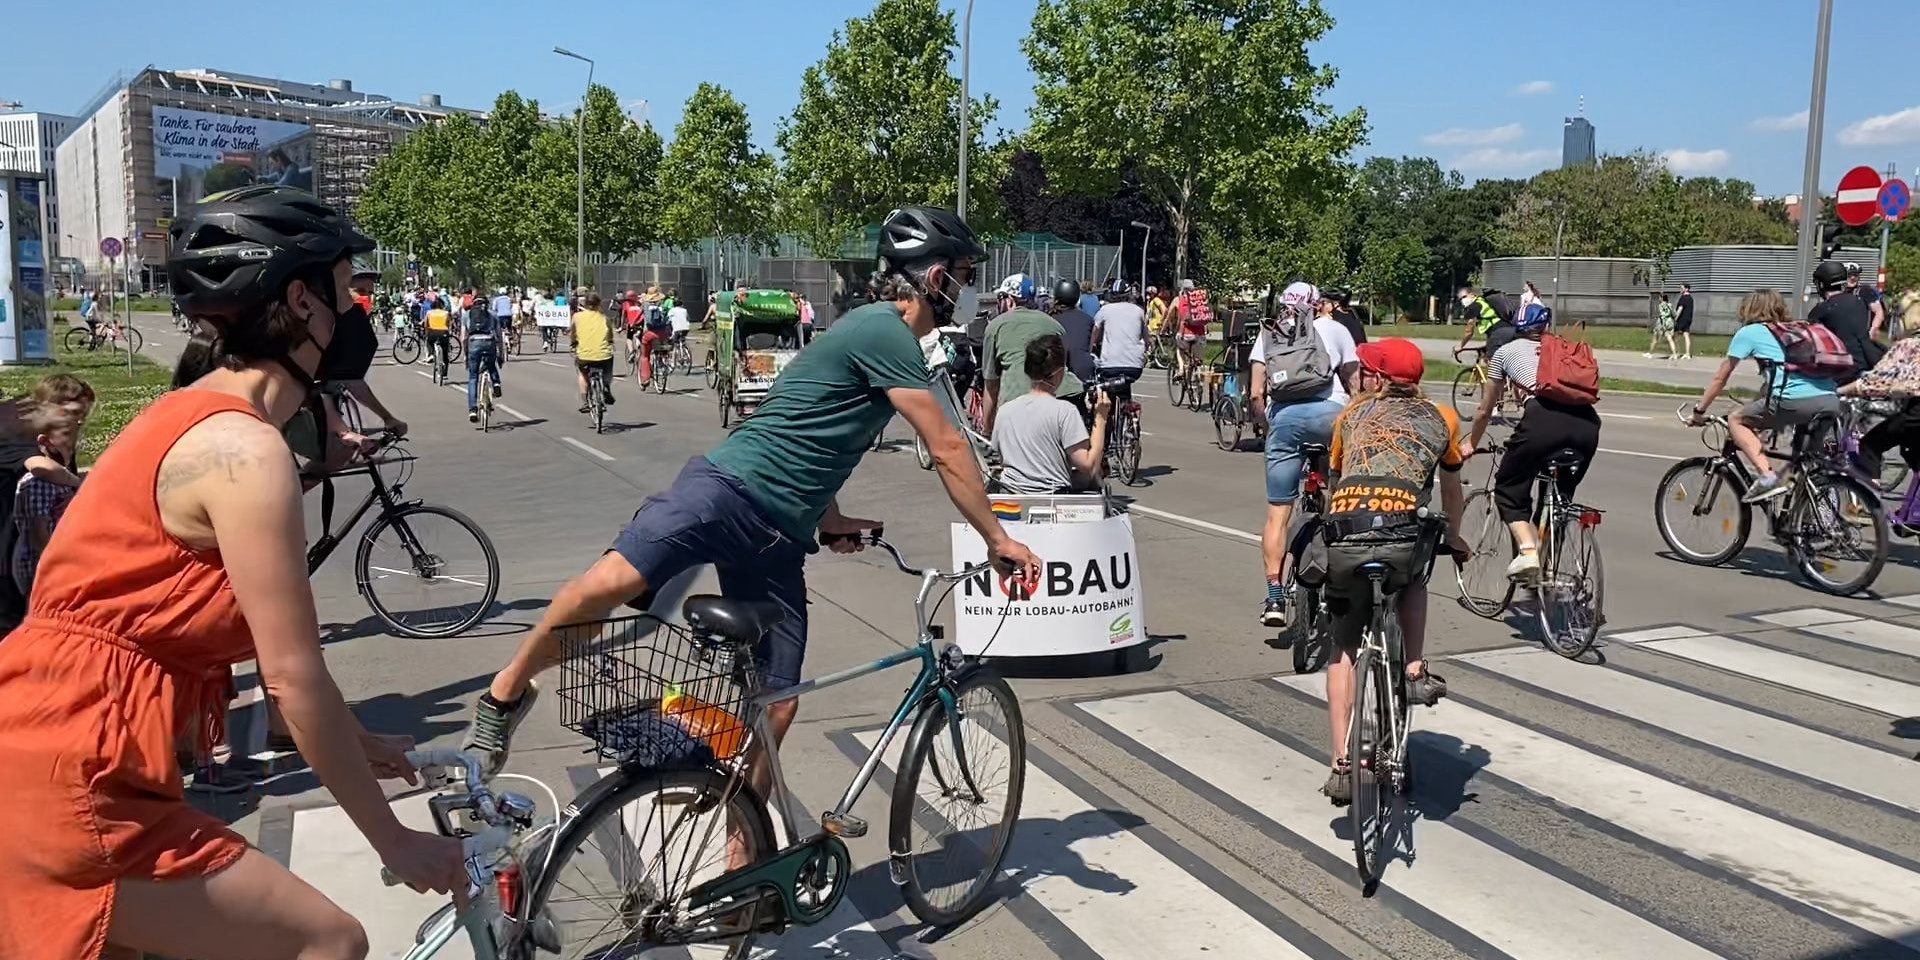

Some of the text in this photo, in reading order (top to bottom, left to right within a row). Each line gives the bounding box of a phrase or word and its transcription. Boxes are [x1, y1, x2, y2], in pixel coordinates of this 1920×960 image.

[159, 115, 257, 136] Tanke. Für sauberes
[164, 132, 260, 151] Klima in der Stadt.
[965, 596, 1134, 617] NEIN ZUR LOBAU-AUTOBAHN!
